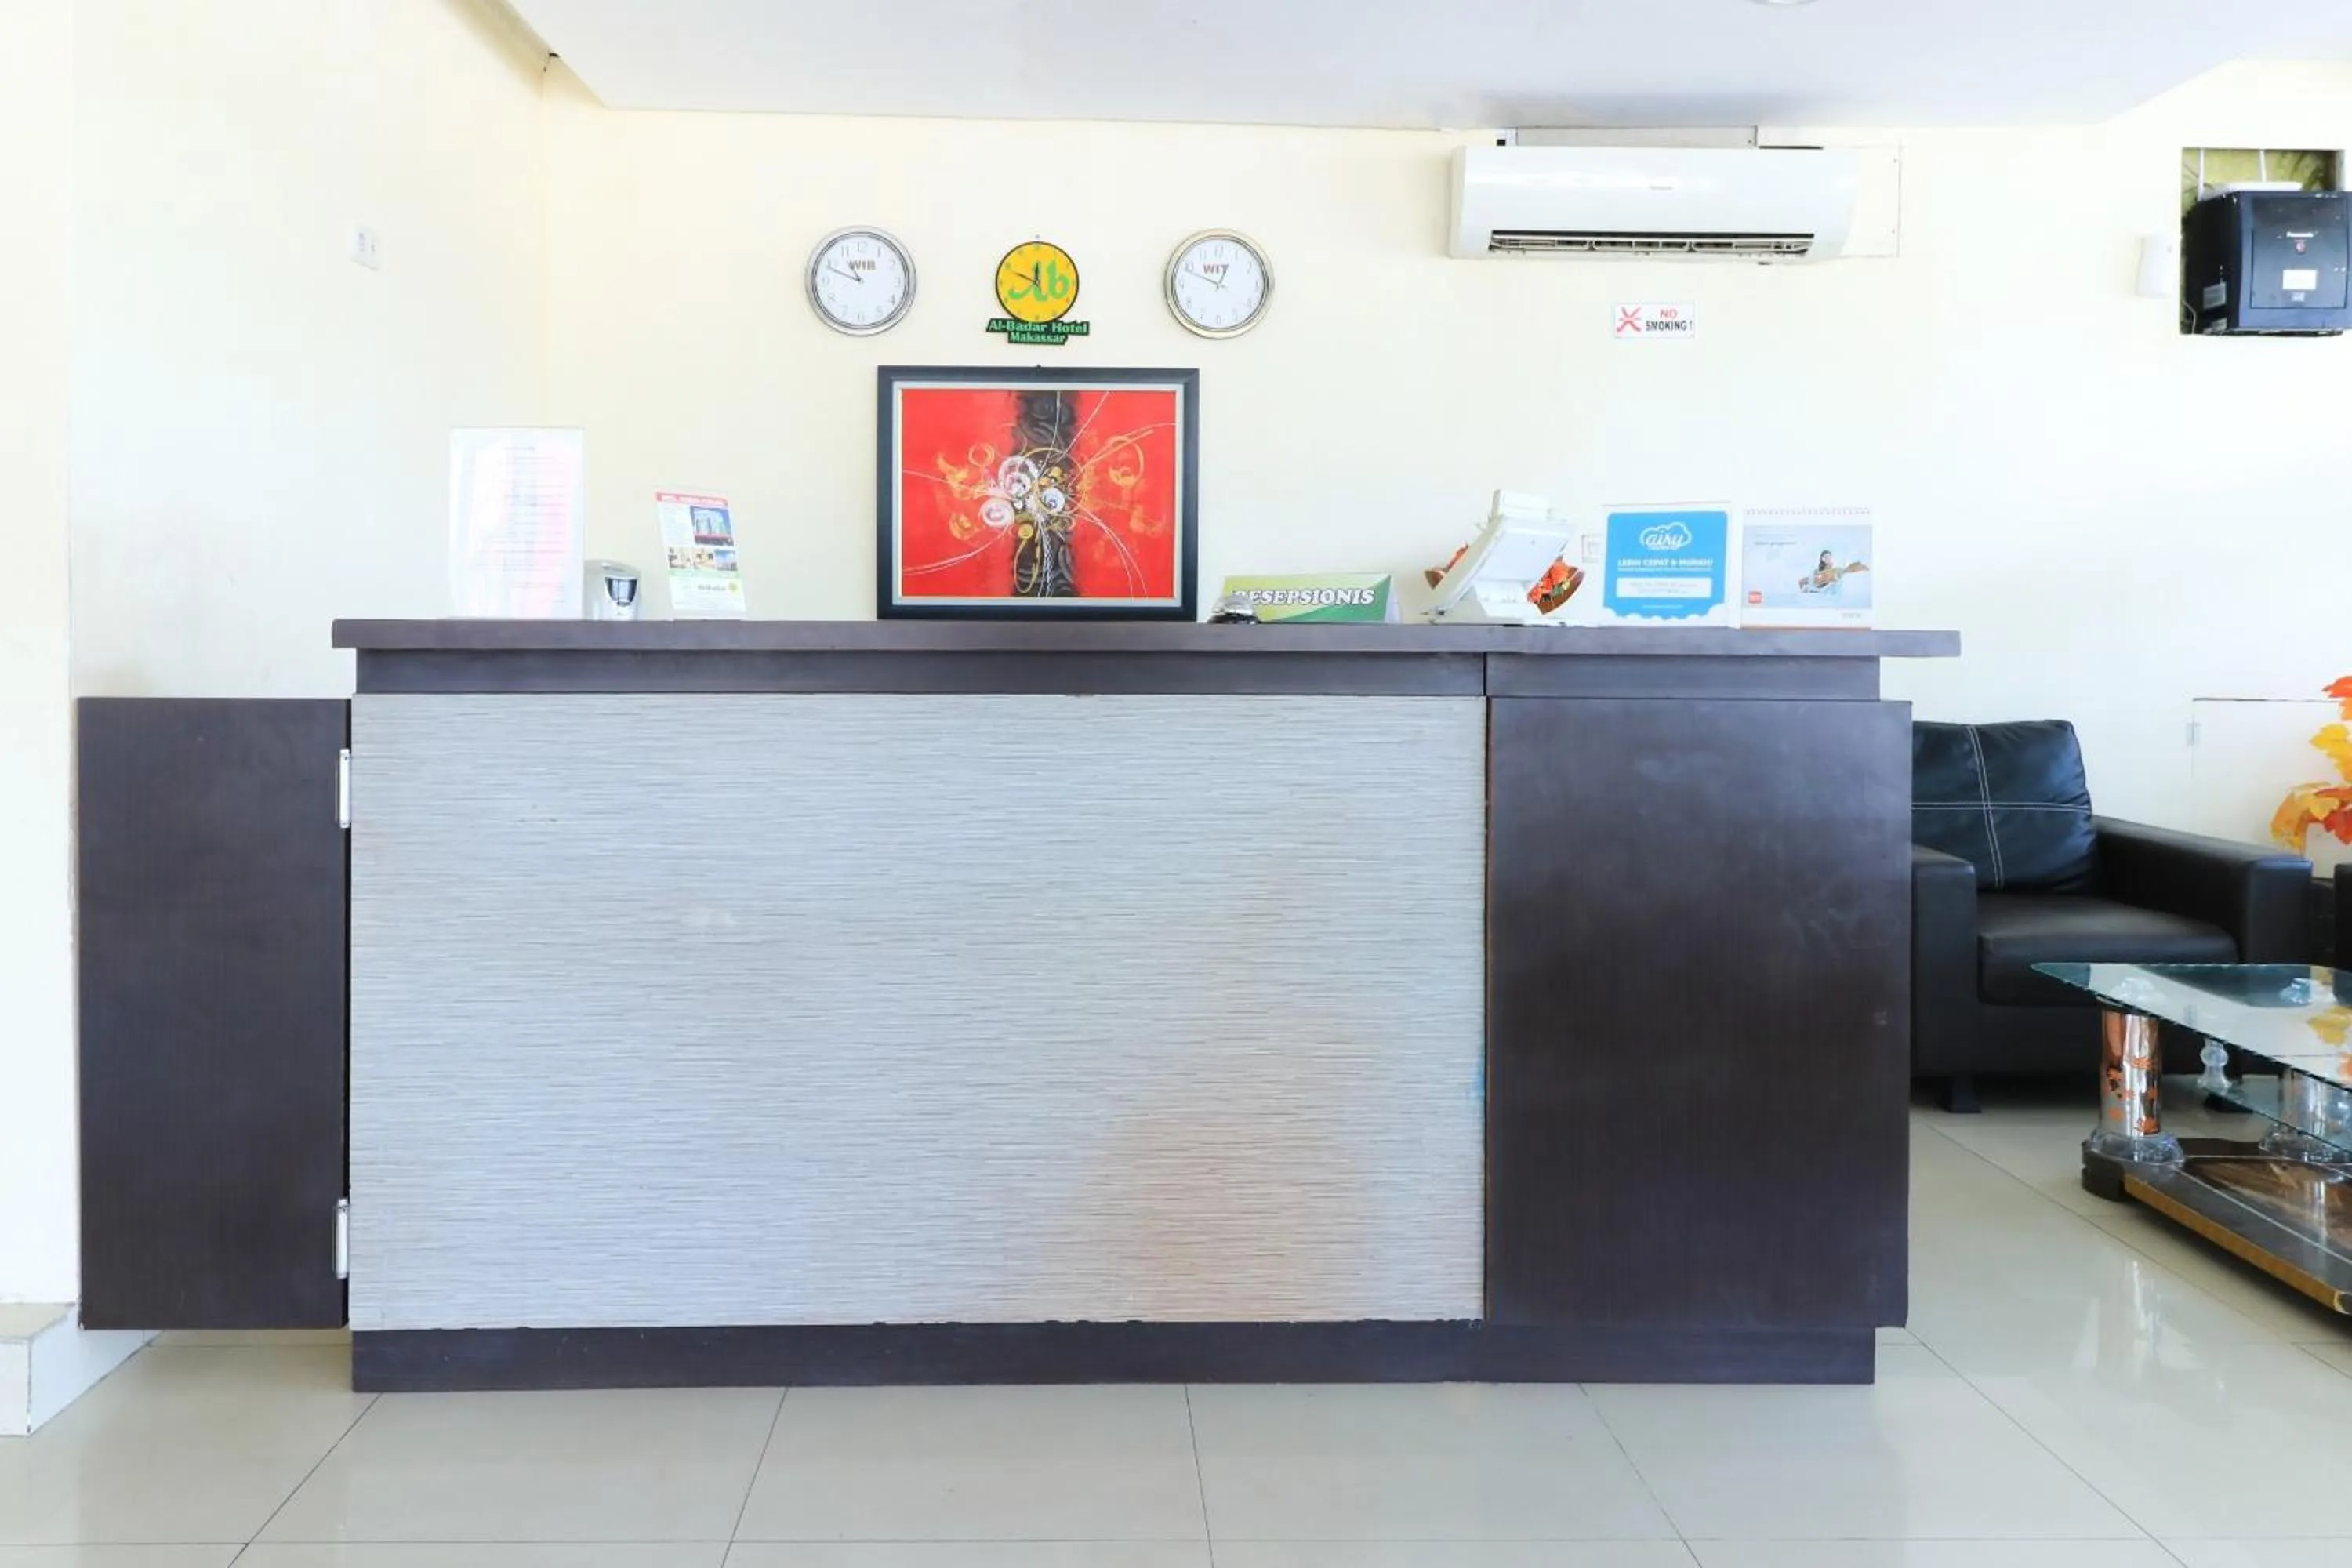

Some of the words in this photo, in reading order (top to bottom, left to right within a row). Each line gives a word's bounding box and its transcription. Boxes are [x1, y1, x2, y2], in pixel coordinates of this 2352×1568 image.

[1660, 309, 1679, 318] NO
[989, 320, 1047, 332] Al-Badar
[1051, 321, 1088, 333] Hotel
[1646, 321, 1687, 332] SMOKING
[1010, 332, 1066, 343] Makassar
[1645, 531, 1684, 550] airy
